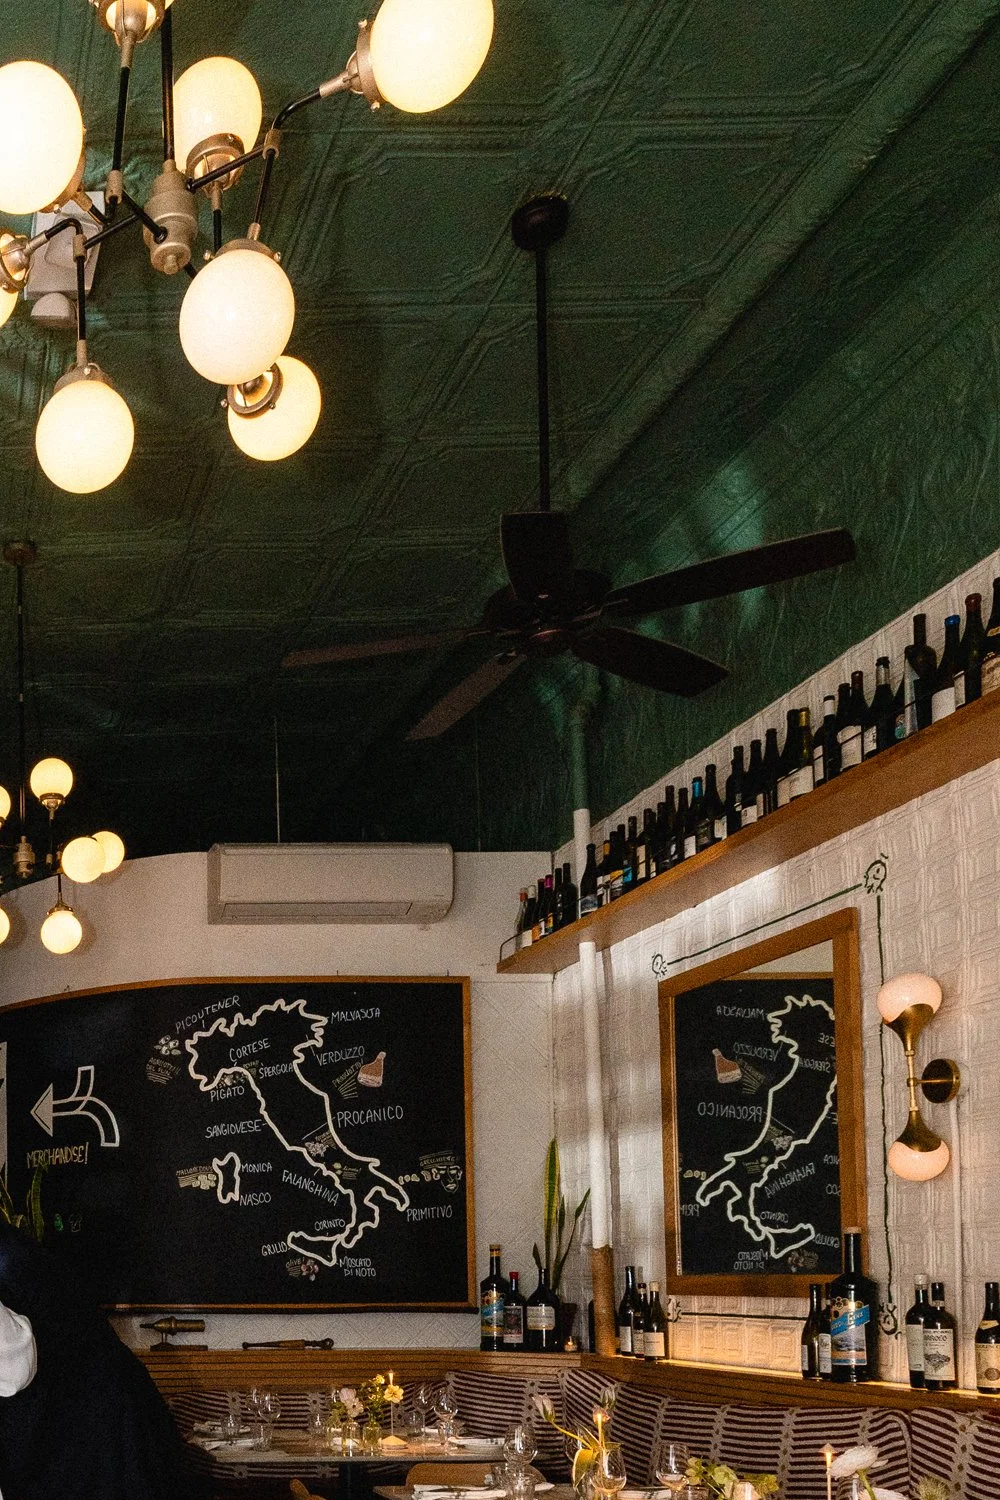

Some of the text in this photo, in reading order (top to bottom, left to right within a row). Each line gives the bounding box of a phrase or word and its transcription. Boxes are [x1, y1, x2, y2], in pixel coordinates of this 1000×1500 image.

[175, 995, 240, 1034] PICOUTENER
[229, 1038, 271, 1063] CORTESE
[316, 1045, 365, 1066] VERDUZZO
[210, 1085, 245, 1102] PIGATO
[337, 1105, 404, 1128] PROCANICO
[205, 1119, 263, 1138] SANGIOVESE
[241, 1162, 273, 1173] MONICA
[282, 1169, 340, 1206] FALANGHINA
[239, 1192, 272, 1206] NASCO
[406, 1205, 453, 1222] PRIMITIVO
[314, 1218, 346, 1231] CORINTO
[262, 1241, 288, 1256] GRILLO
[344, 1268, 377, 1277] DI NOTO
